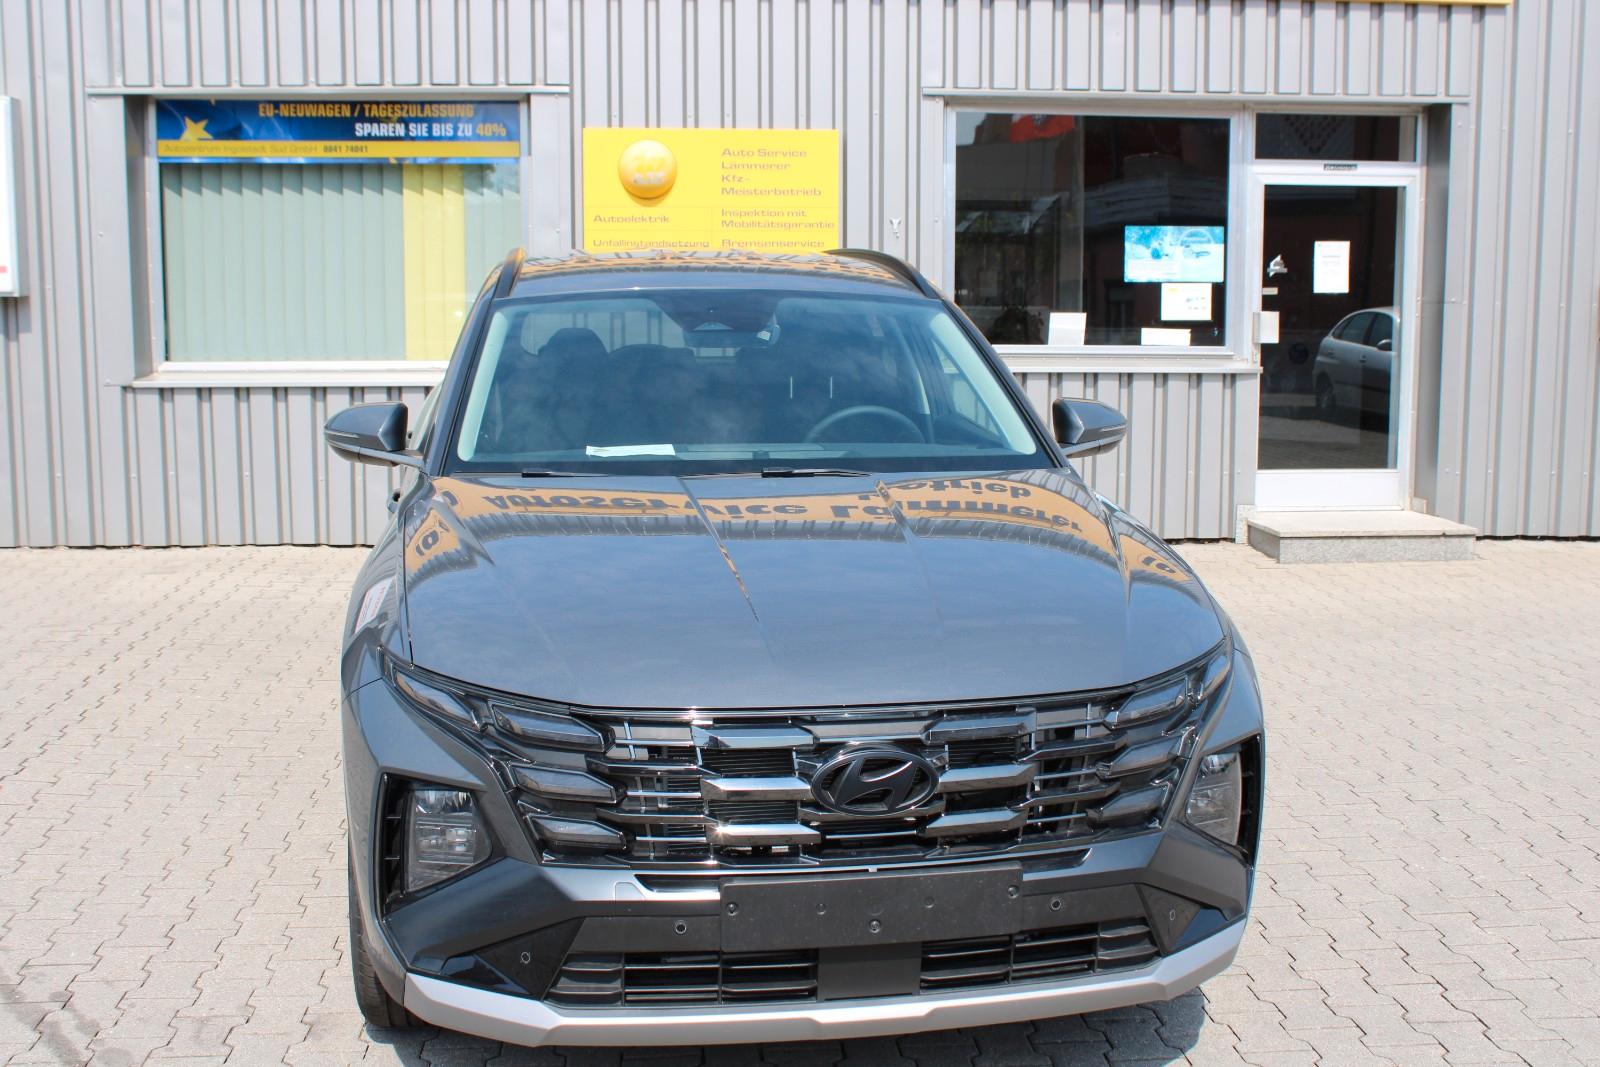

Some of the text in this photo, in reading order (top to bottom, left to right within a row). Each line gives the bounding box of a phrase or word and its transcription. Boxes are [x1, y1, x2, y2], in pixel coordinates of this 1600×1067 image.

[258, 103, 351, 117] EU-NEUWAGEN
[363, 103, 474, 117] TAGESZULASSUNG
[355, 122, 507, 137] SPAREN SIE BIS ZU 40%
[721, 148, 807, 158] Auto Service
[721, 187, 822, 196] Meisterbetrieb
[721, 209, 807, 218] Inspektion mit
[593, 215, 670, 223] Autoelektrik
[721, 220, 835, 230] Mobilitätsgarantie
[721, 239, 825, 248] Bremsenservice
